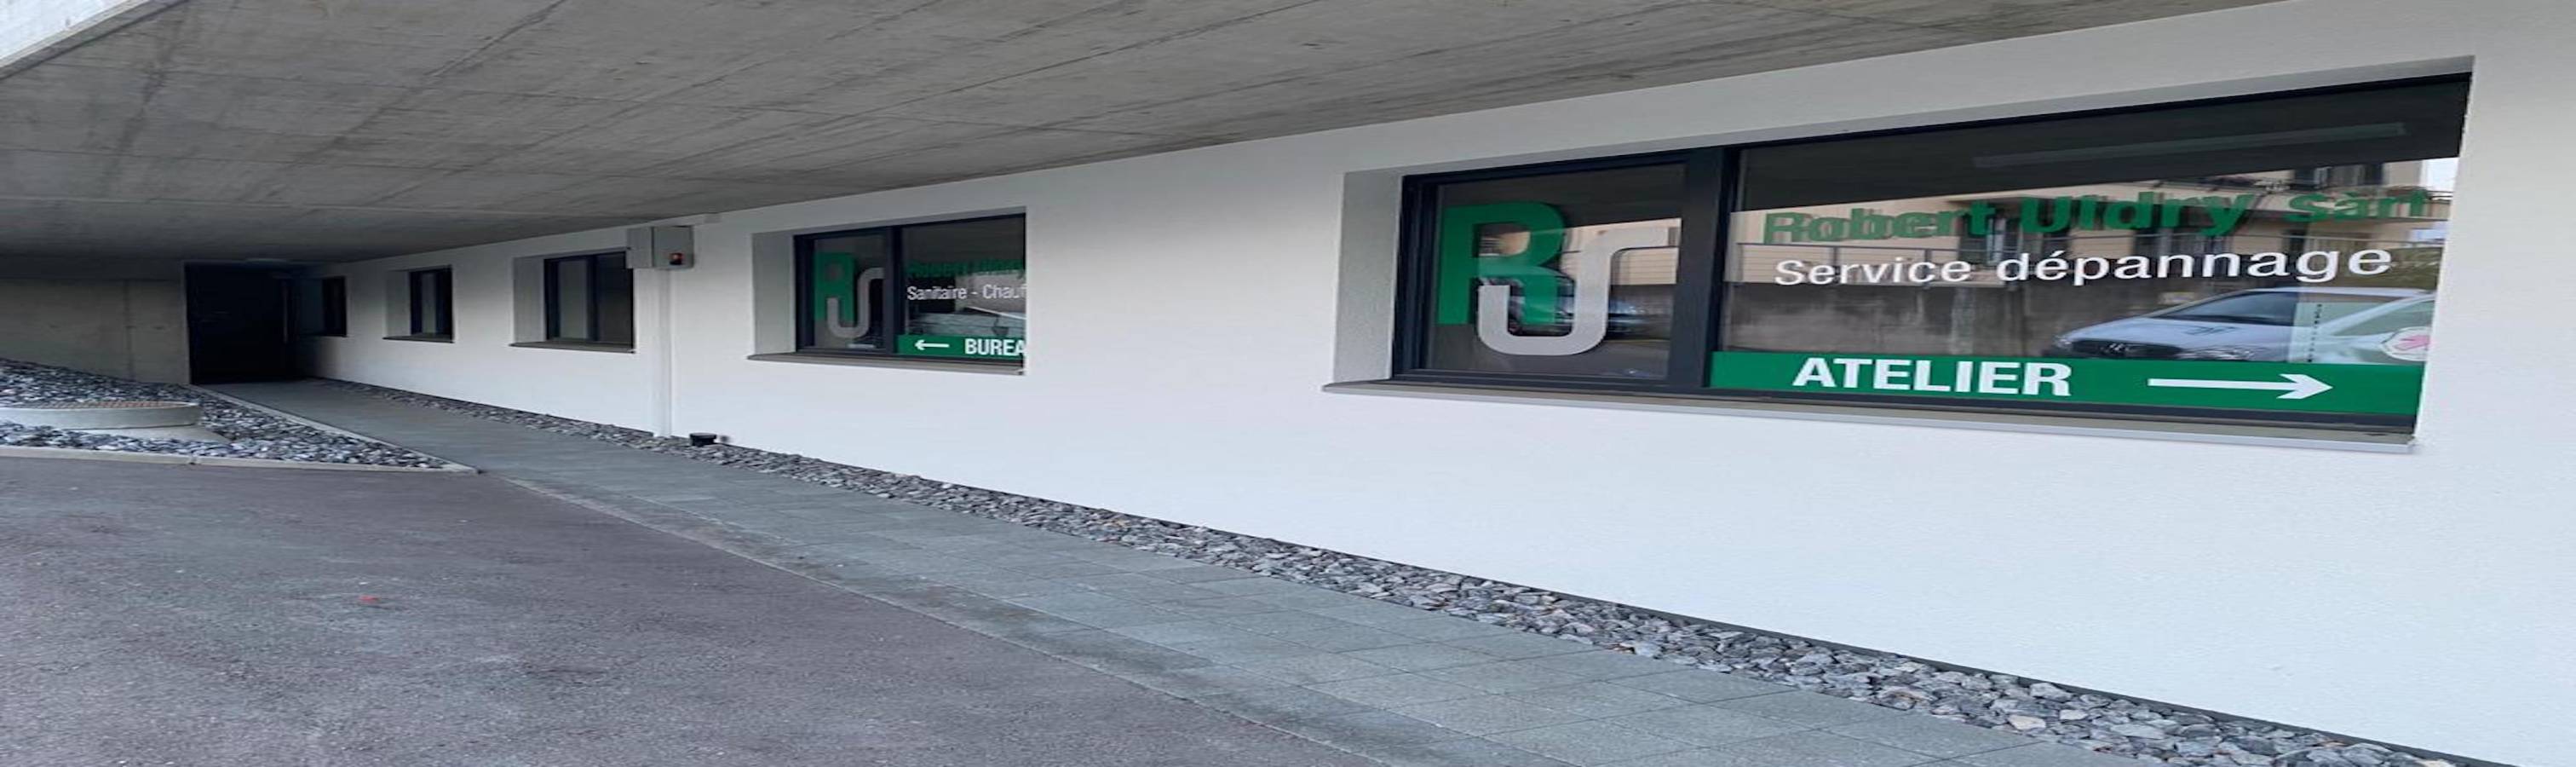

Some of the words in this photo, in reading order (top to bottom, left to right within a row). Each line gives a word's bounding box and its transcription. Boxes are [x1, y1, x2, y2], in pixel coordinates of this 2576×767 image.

[1763, 200, 1997, 245] Robert
[2020, 191, 2255, 237] Uldry
[1774, 257, 1972, 286] Service
[1996, 248, 2392, 286] dépannage
[906, 285, 968, 300] Sanitaire
[1792, 356, 2073, 397] ATELIER
